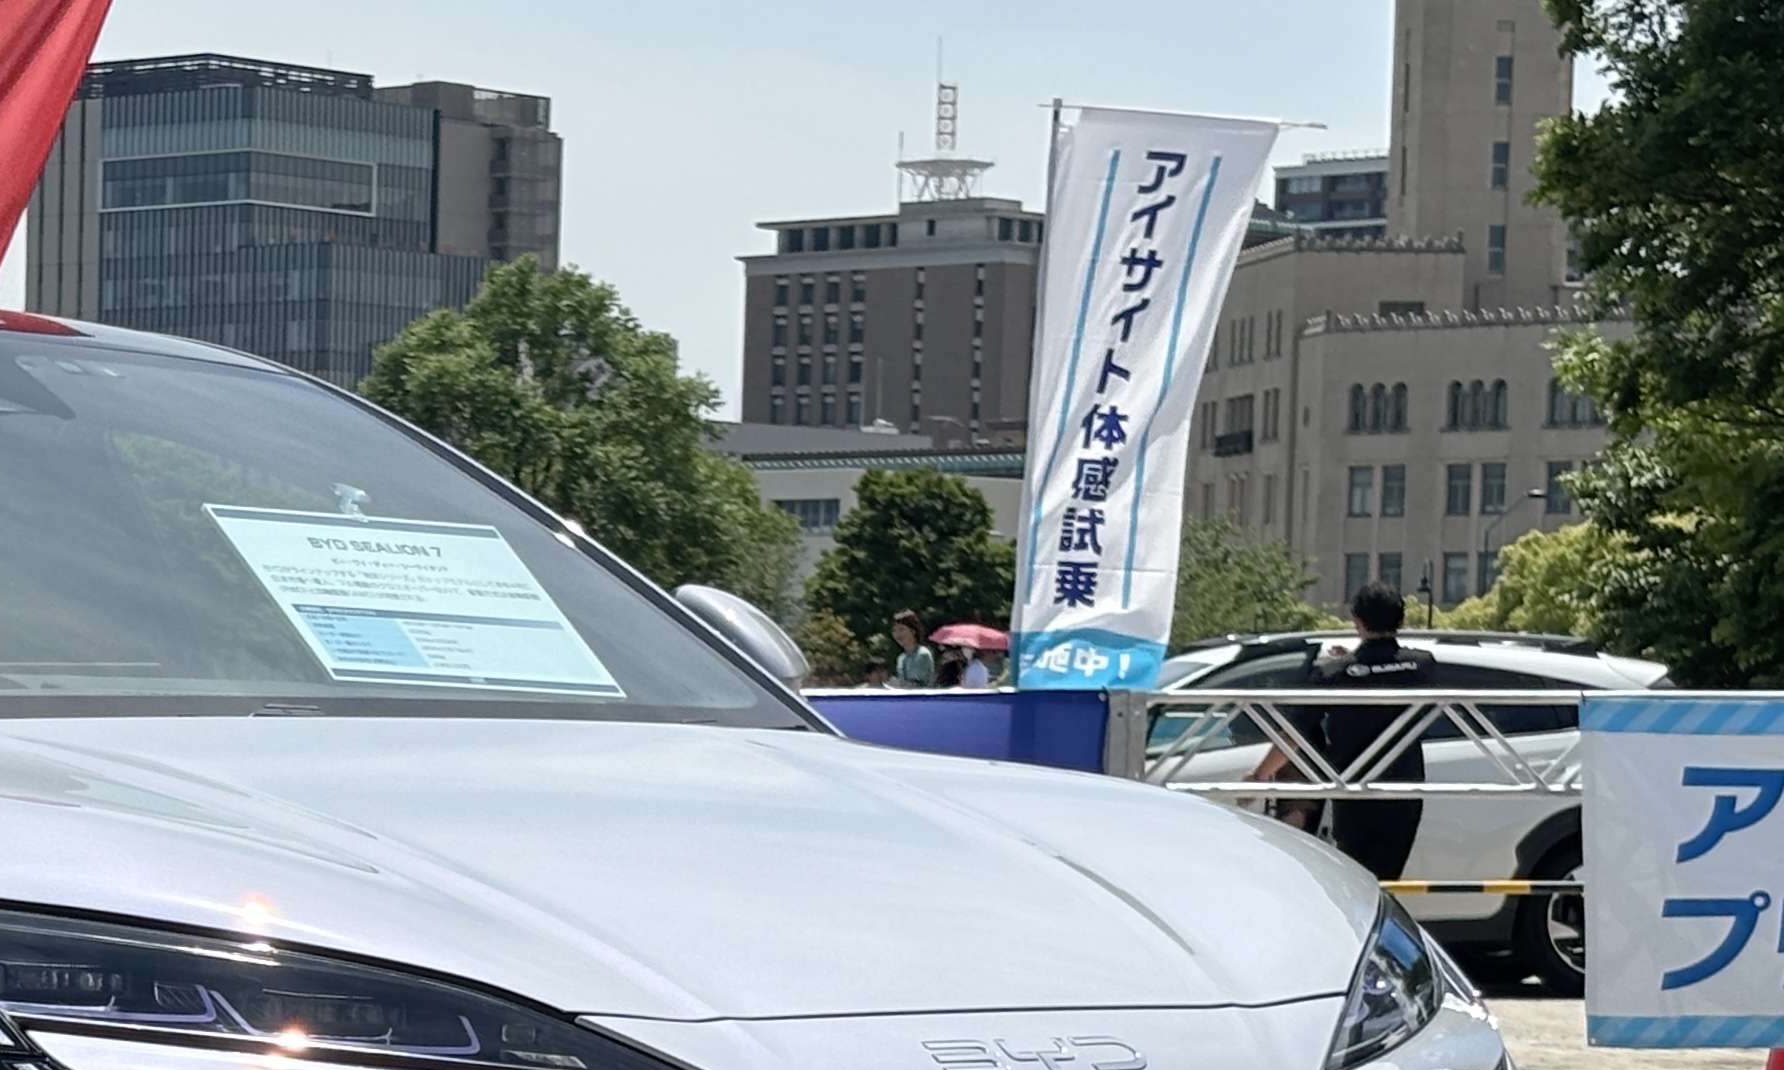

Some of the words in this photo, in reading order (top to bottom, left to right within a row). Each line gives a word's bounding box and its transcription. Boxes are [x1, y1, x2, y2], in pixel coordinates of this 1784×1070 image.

[1054, 149, 1188, 609] アイサイト体感試乗
[306, 536, 348, 551] BYD
[349, 540, 430, 557] SEALION
[430, 546, 442, 558] 7
